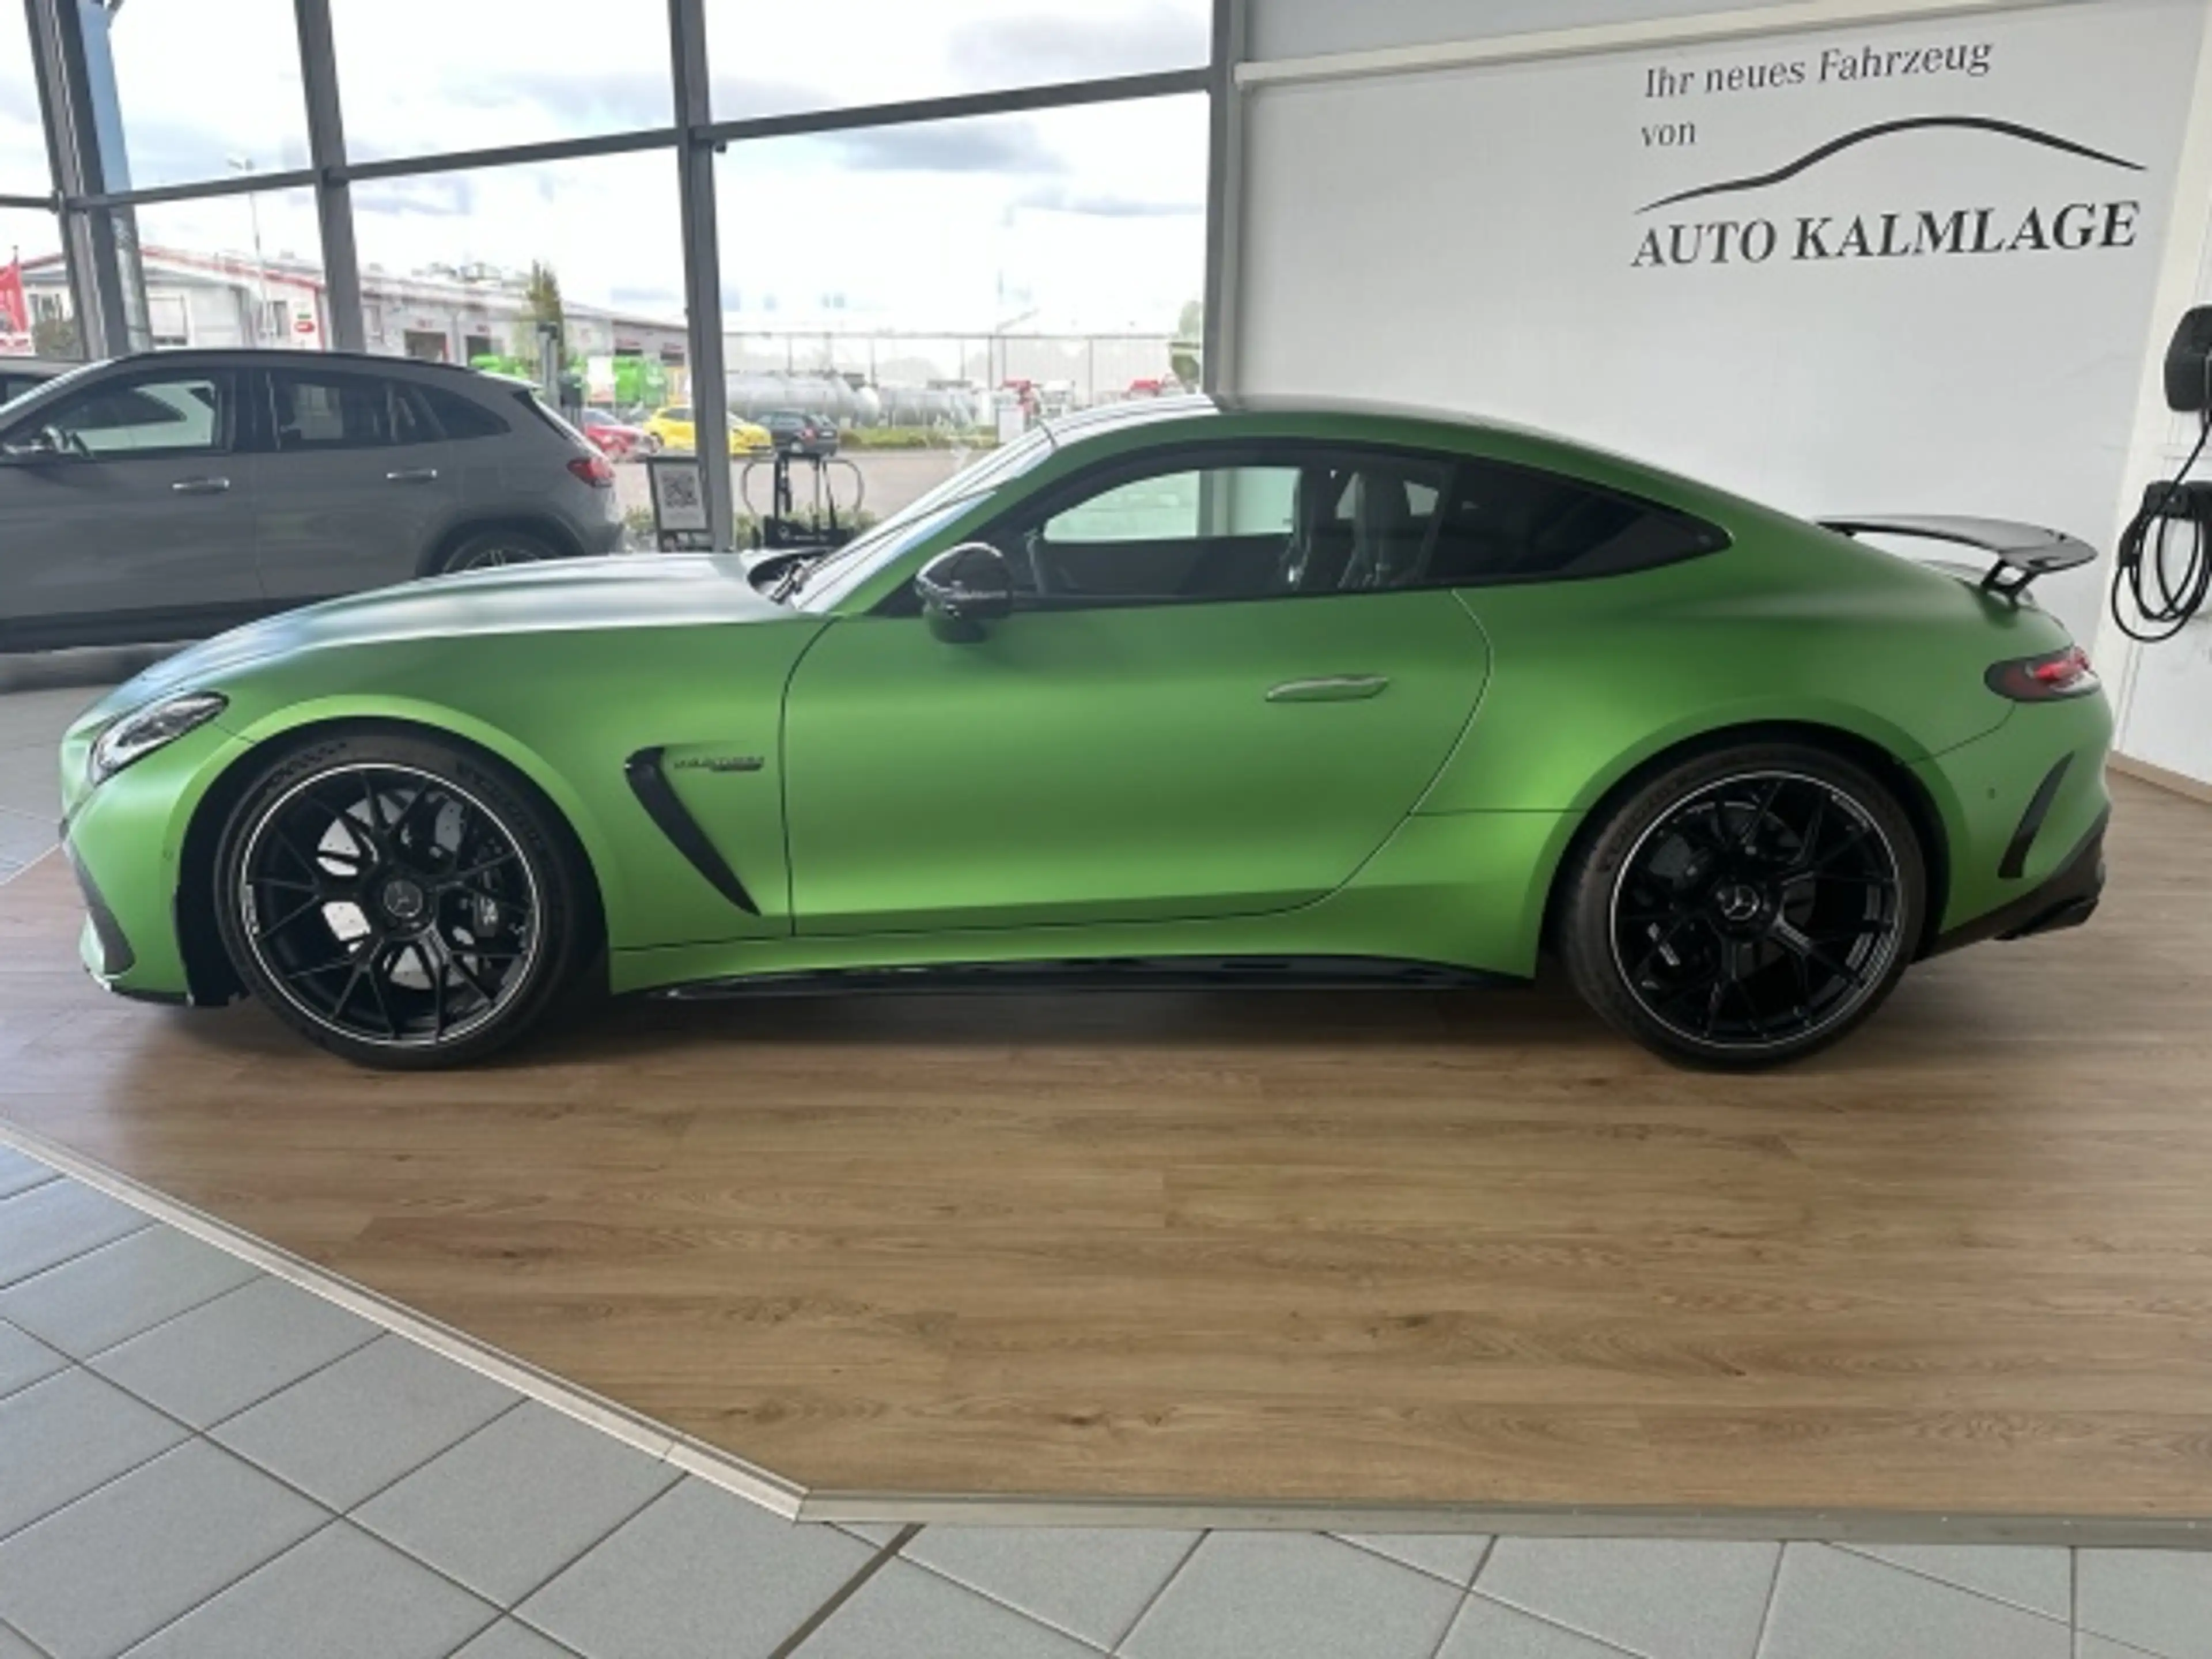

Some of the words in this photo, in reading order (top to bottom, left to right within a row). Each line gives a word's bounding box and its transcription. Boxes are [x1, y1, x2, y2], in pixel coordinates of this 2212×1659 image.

[1644, 66, 1695, 99] Ihr
[1704, 60, 1806, 94] neues
[1817, 43, 1993, 84] Fahrzeug
[1641, 122, 1696, 147] von
[1630, 218, 1777, 267] AUTO
[1790, 200, 2141, 261] KALMLAGE
